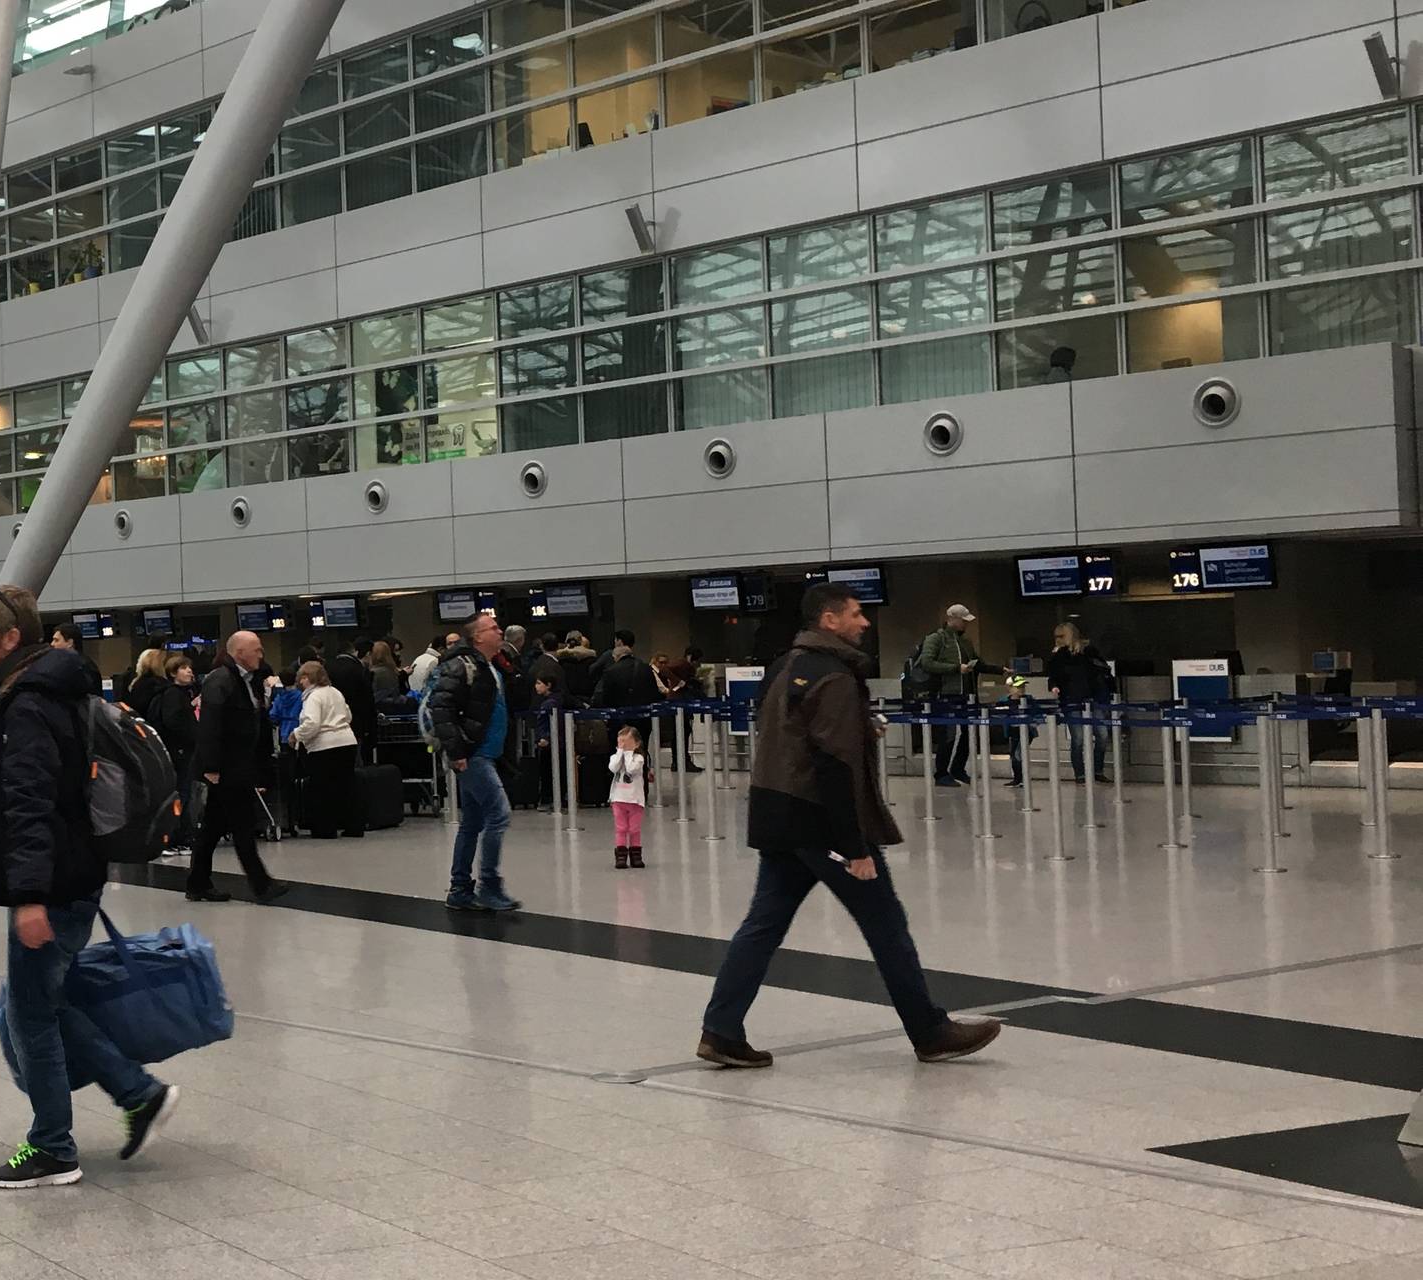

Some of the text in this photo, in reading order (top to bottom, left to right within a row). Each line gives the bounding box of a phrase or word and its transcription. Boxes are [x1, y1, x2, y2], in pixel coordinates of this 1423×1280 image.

[1088, 577, 1113, 591] 177
[1172, 573, 1199, 587] 176
[745, 595, 764, 606] 179
[1208, 663, 1225, 671] DUS
